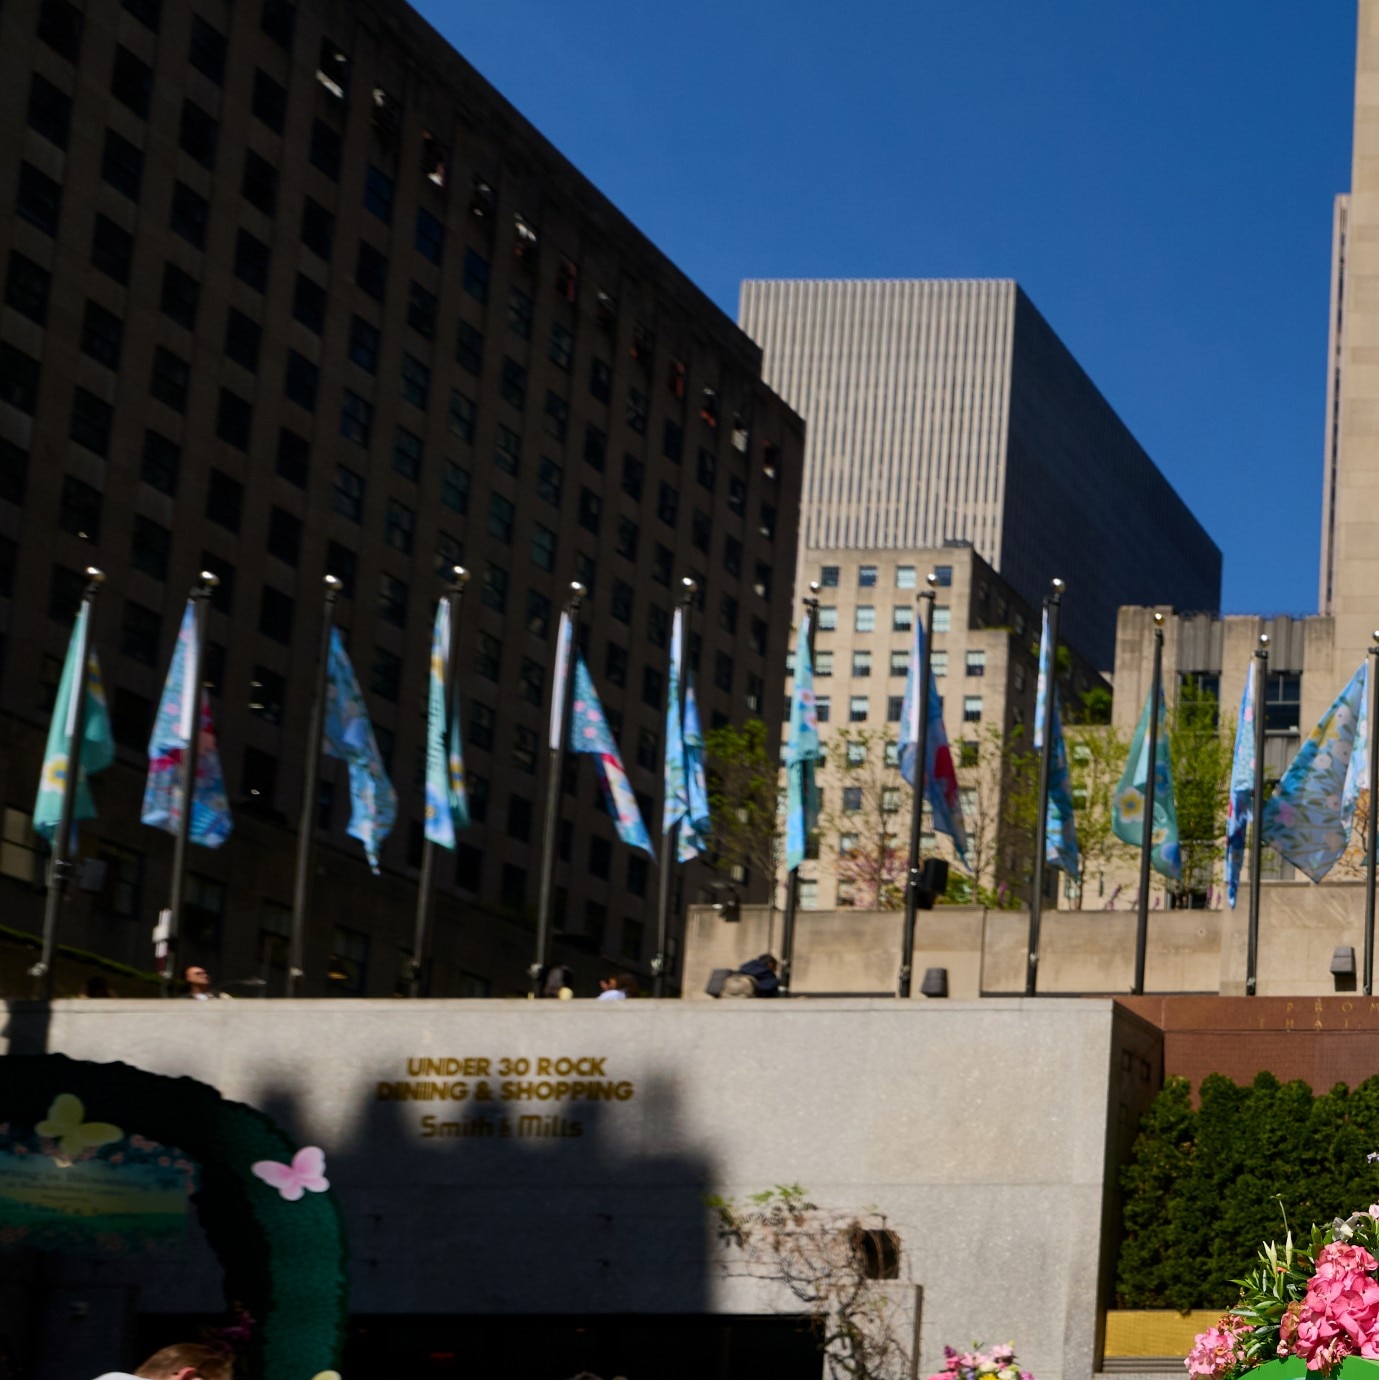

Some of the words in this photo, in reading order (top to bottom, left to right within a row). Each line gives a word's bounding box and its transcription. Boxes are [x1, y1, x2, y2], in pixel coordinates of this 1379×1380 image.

[407, 1057, 490, 1076] UNDER
[498, 1057, 530, 1076] 30
[536, 1057, 607, 1076] ROCK
[377, 1081, 470, 1101] DINING
[475, 1081, 495, 1101] &
[500, 1081, 634, 1101] SHOPPING
[420, 1115, 494, 1138] Smith
[518, 1115, 583, 1138] Mills
